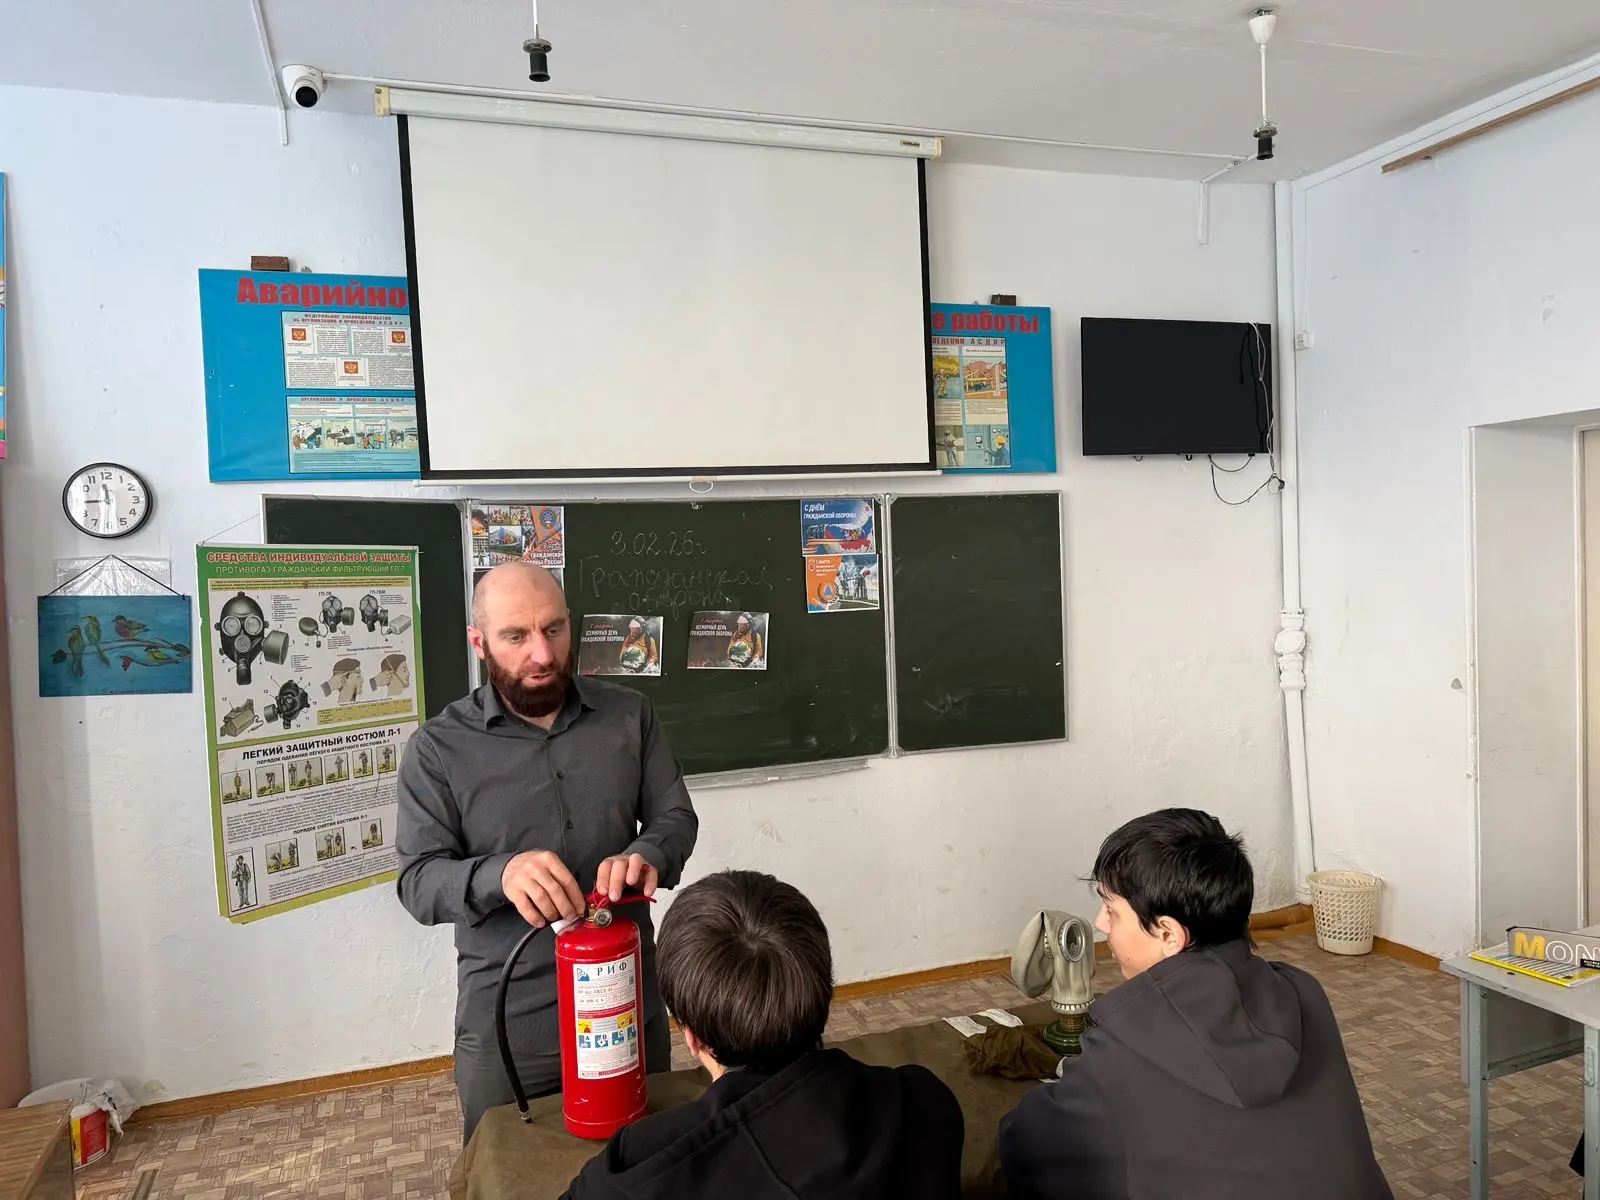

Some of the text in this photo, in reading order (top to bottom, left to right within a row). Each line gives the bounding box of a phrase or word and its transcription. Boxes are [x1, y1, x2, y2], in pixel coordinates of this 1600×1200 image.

[236, 277, 407, 308] Аварийно
[951, 311, 1040, 333] работы
[87, 475, 96, 484] 11
[100, 471, 113, 481] 12
[119, 475, 124, 484] 1
[127, 483, 136, 492] 2
[131, 495, 140, 505] 3
[128, 508, 137, 516] 4
[91, 518, 98, 527] 7
[119, 517, 128, 526] 5
[207, 551, 412, 564] СРЕДСТВА ИНДИВИДУАЛЬНОЙ ЗАЩИТЫ
[216, 566, 272, 574] ПРОТИВОГАЗ
[273, 565, 331, 574] ГРАЖДАНСКИЙ
[332, 565, 389, 573] ФИЛЬТРУЮЩИЙ
[242, 727, 401, 760] ЛЕГКИЙ ЗАЩИТНЫЙ КОСТЮМ Л-1
[256, 757, 281, 766] ПОРЯДОК
[281, 752, 309, 762] ОДЕВАНИЯ
[331, 744, 360, 753] ЗАЩИТНОГО
[293, 826, 317, 835] ПОРЯДОК
[316, 821, 337, 830] СНЯТИЯ
[336, 816, 360, 825] КОСТЮМА
[597, 961, 627, 977] РИФ
